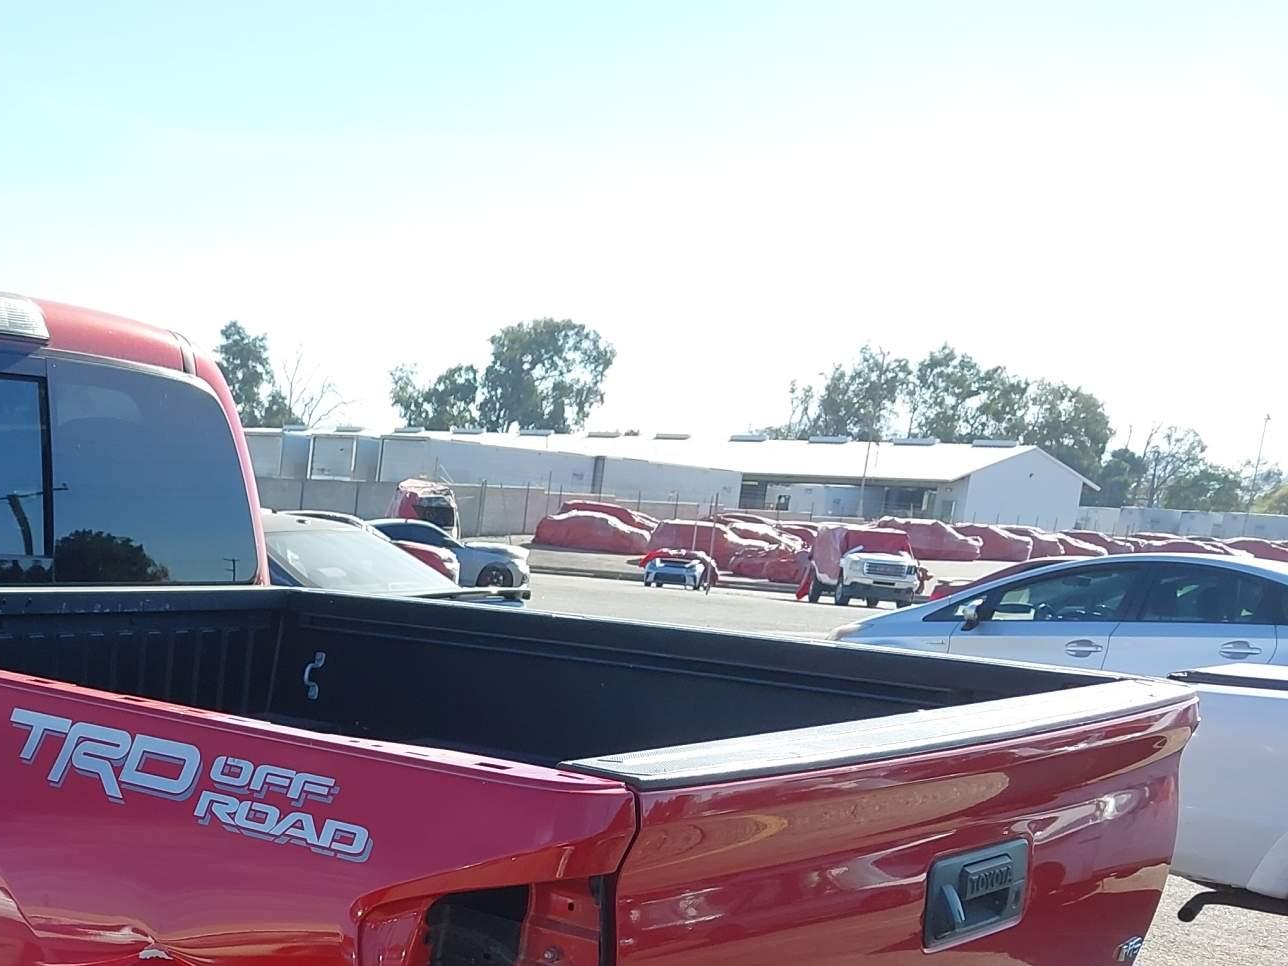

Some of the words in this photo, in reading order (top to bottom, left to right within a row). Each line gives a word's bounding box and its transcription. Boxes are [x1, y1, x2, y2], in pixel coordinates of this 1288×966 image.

[10, 707, 202, 803] TRD
[209, 755, 340, 806] OFF
[192, 790, 374, 863] ROAD
[968, 865, 1012, 893] TOYOTA
